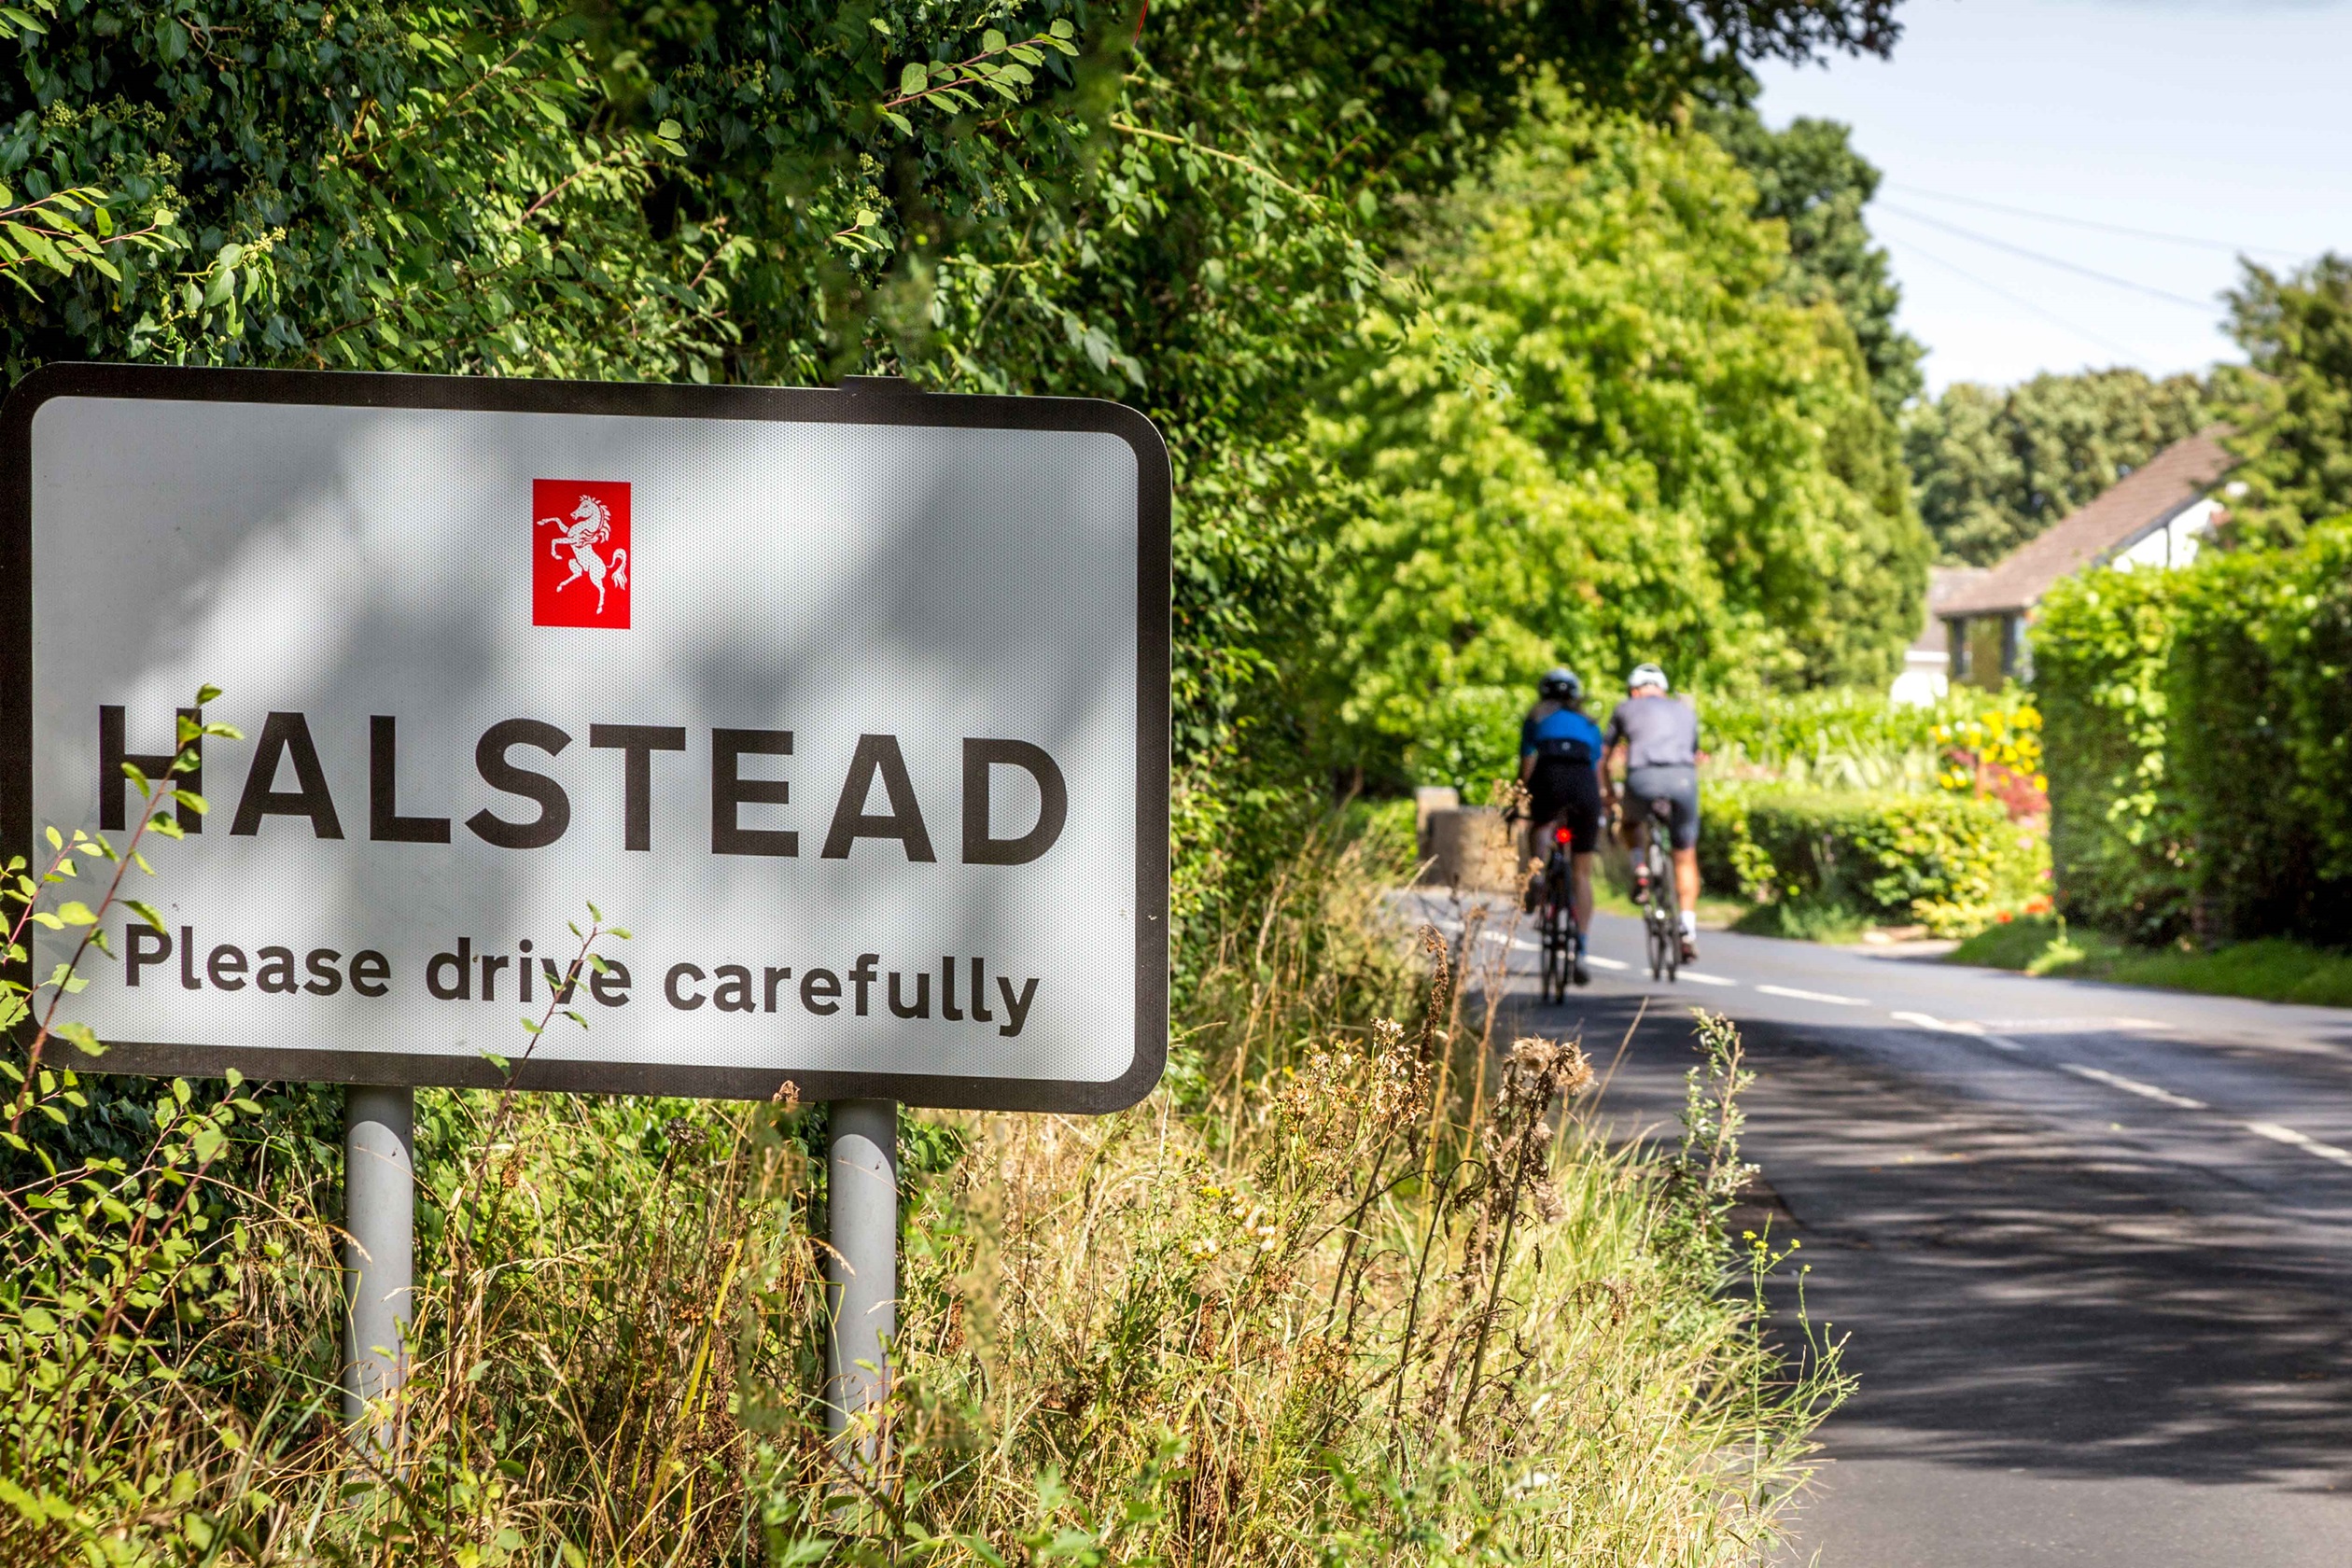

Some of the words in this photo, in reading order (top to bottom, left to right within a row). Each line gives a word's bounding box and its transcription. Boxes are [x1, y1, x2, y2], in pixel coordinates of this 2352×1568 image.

[100, 705, 1069, 866] HALSTEAD
[126, 924, 391, 998] Please
[427, 936, 633, 1008] drive
[664, 954, 1040, 1037] carefully
